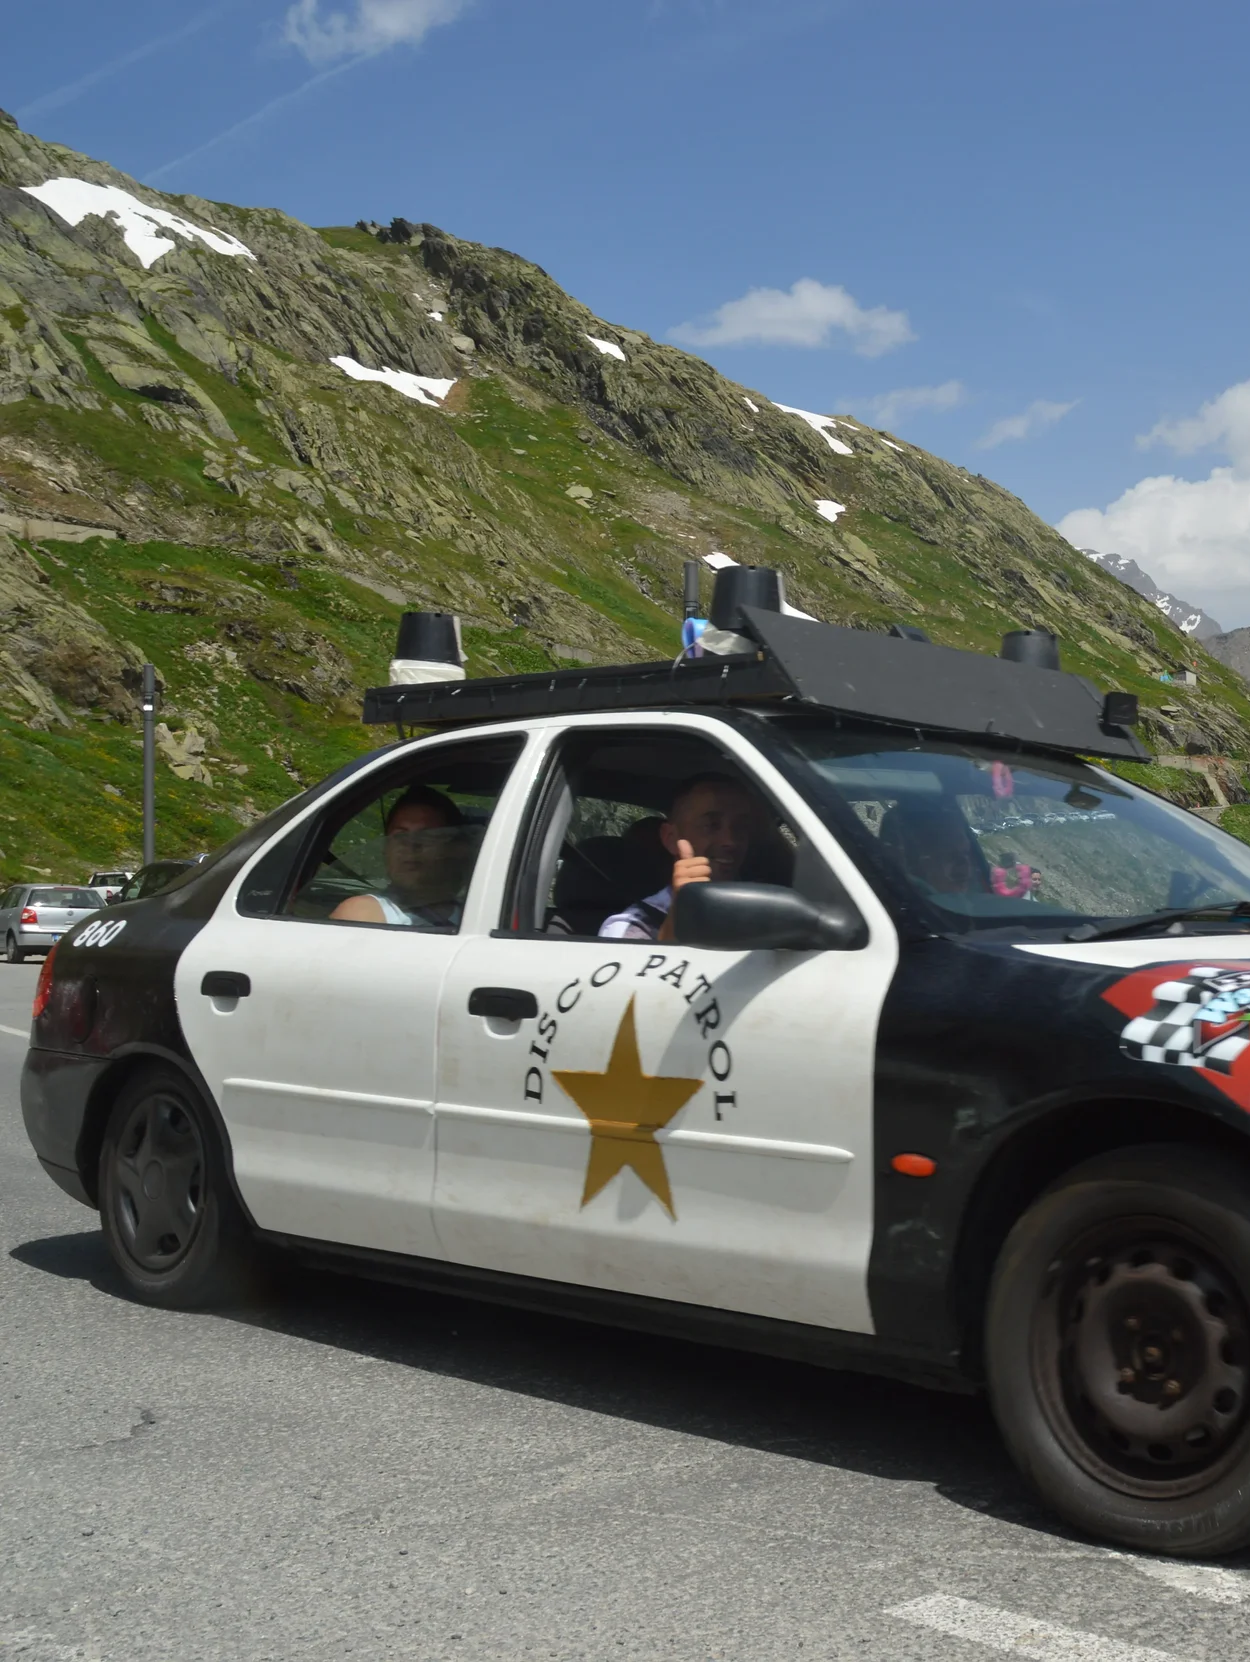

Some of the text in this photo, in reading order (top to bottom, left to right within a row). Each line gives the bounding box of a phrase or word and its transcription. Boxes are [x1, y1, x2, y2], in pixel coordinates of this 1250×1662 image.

[72, 919, 127, 947] 860
[524, 954, 737, 1121] DISCO PATROL
